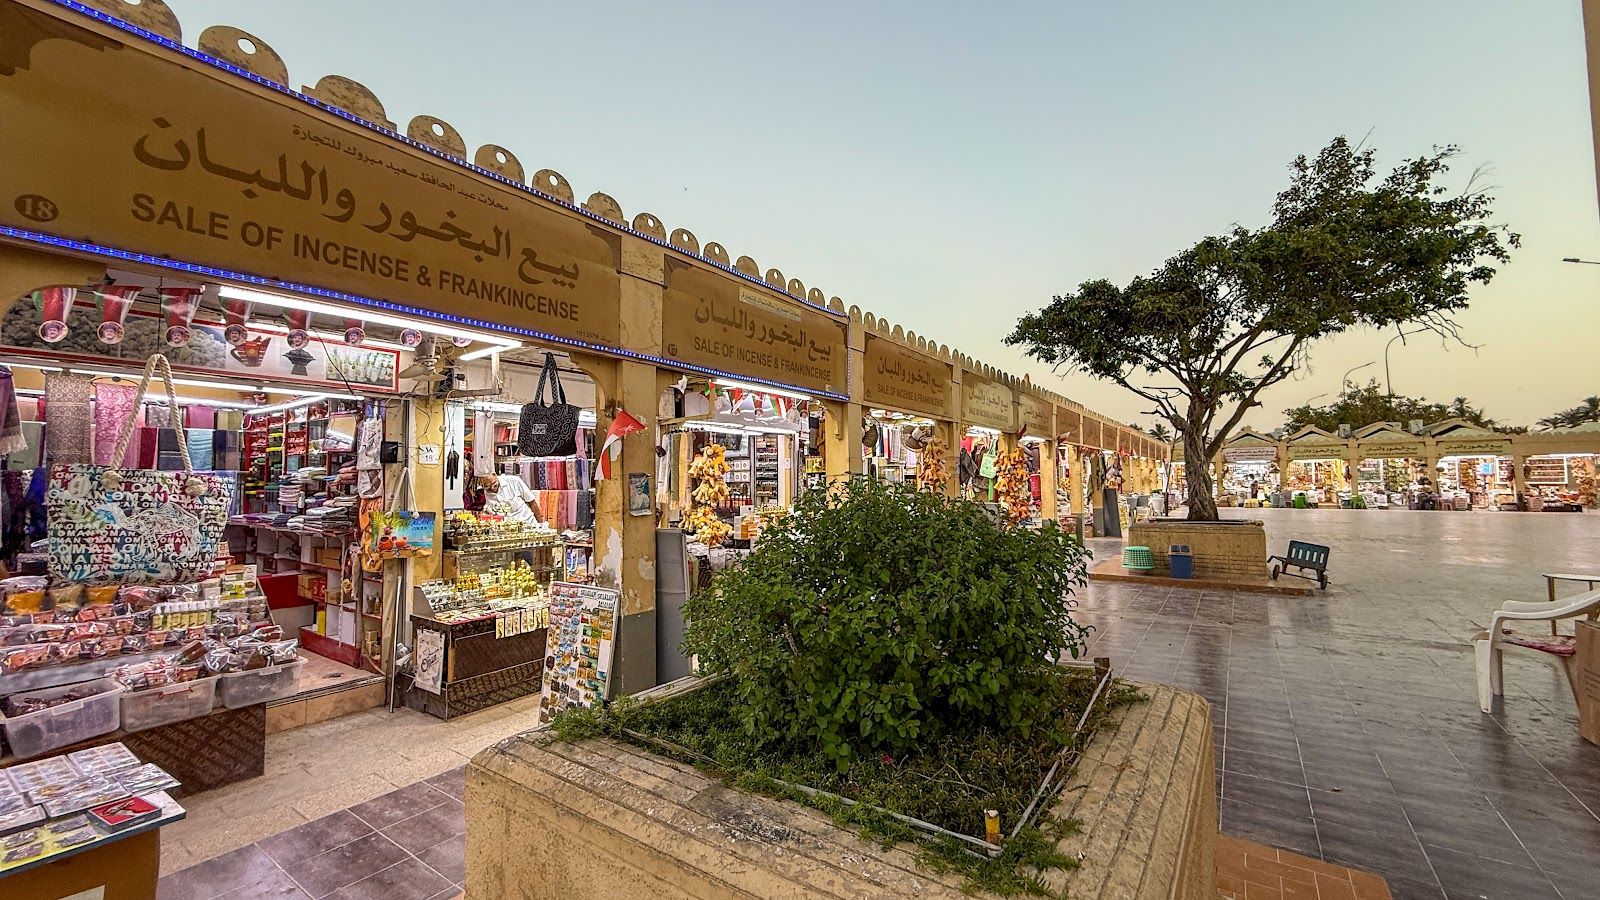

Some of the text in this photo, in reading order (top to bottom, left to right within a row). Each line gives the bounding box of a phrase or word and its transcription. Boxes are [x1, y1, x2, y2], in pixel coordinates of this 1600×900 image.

[292, 124, 342, 152] للتجارة
[23, 199, 52, 219] 18
[132, 116, 580, 290] بيع البخور واللبان
[131, 193, 579, 322] SALE OF INCENSE & FRANKINCENSE
[694, 297, 756, 339] واللبان
[758, 324, 807, 353] البخور
[808, 338, 831, 362] بيع
[694, 336, 831, 382] SALE OF INCENSE & FRANKINCENSE
